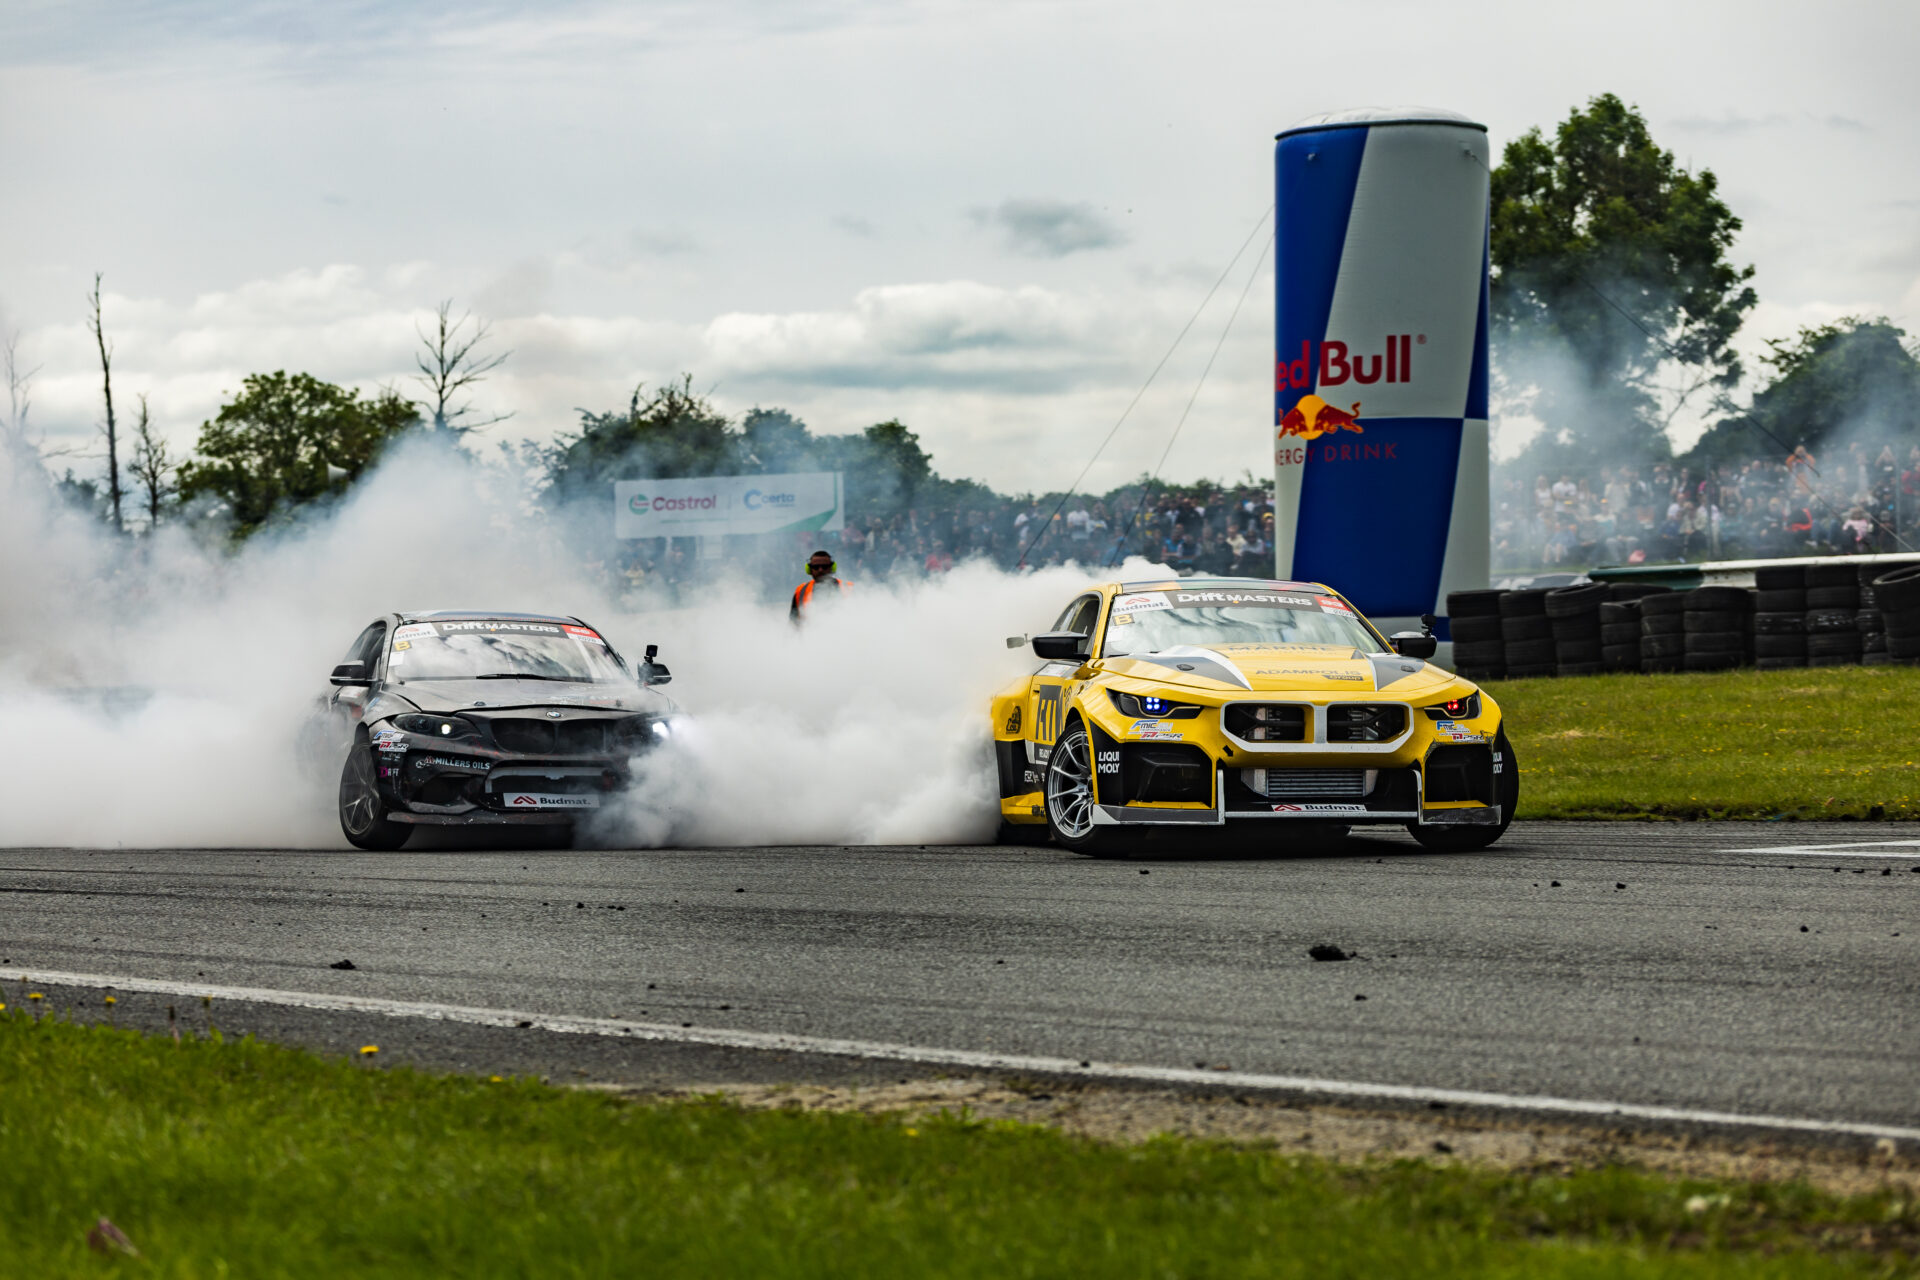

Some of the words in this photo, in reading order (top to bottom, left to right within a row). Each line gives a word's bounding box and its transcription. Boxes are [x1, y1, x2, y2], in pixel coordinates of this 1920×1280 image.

[1274, 339, 1310, 392] ed
[1325, 443, 1398, 463] DRINK
[652, 493, 717, 511] Castrol
[1177, 592, 1226, 602] Drift
[1224, 594, 1312, 606] MASTERS
[1113, 614, 1133, 625] B
[485, 623, 559, 633] MASTERS
[395, 640, 411, 652] B
[1098, 751, 1120, 762] LIQUI
[435, 757, 471, 768] MILLERS
[472, 761, 491, 770] OILS
[1097, 763, 1120, 774] MOLY
